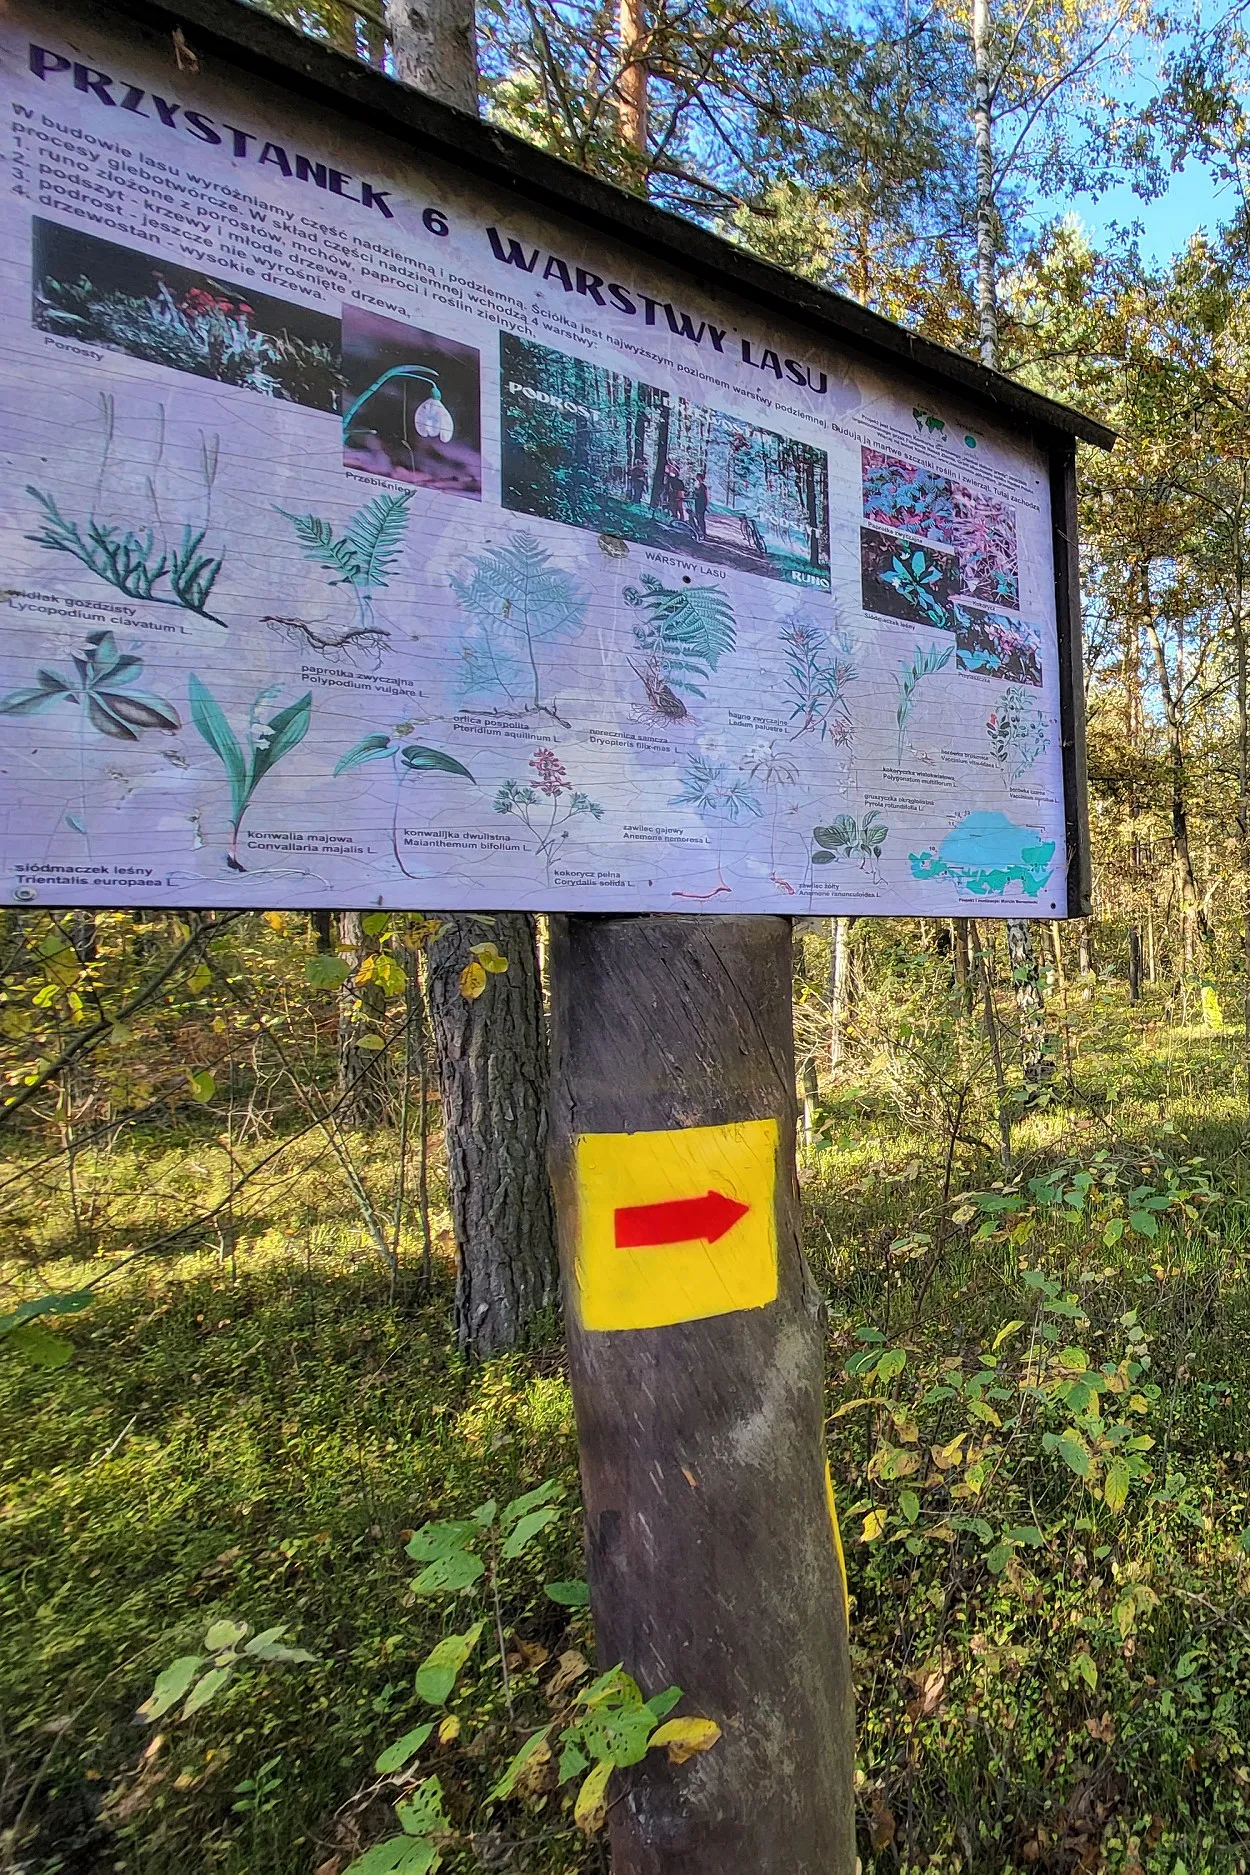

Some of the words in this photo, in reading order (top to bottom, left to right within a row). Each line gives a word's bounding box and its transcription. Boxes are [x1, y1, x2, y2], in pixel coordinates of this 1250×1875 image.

[12, 152, 31, 168] 2.
[39, 164, 126, 201] podszyt
[144, 200, 211, 234] krzewy
[228, 232, 284, 258] młode
[289, 254, 353, 284] drzewa,
[29, 42, 395, 219] PRZYSTANEK
[422, 208, 449, 237] 6
[486, 226, 727, 354] WARSTWY
[742, 338, 828, 394] LASU
[11, 184, 32, 200] 4.
[38, 193, 161, 244] drzewostan
[180, 244, 256, 276] wysokie
[261, 271, 326, 302] drzewa.
[12, 122, 100, 162] procesy
[108, 157, 244, 216] glebotwórcze.
[249, 208, 267, 222] W
[272, 220, 318, 242] skład
[324, 238, 374, 264] części
[378, 258, 464, 299] nadziemnej
[468, 292, 528, 324] wchodzą
[531, 316, 539, 326] 4
[542, 321, 598, 349] warstwy:
[12, 166, 30, 183] 3.
[39, 178, 124, 216] podrost
[142, 214, 214, 248] jeszcze
[220, 242, 247, 260] nie
[252, 254, 346, 294] wyrośnięte
[352, 289, 411, 319] drzewa,
[13, 136, 30, 151] 1.
[38, 146, 89, 172] runo
[96, 168, 175, 204] złożone
[180, 200, 192, 210] z
[196, 206, 286, 246] porostów,
[292, 240, 356, 272] mchów,
[360, 267, 418, 294] paproci
[432, 293, 473, 314] roślin
[477, 308, 536, 338] zielnych,
[12, 102, 34, 119] W
[42, 114, 132, 158] budowie
[140, 152, 180, 177] lasu
[186, 171, 295, 221] wyróżniamy
[300, 215, 348, 240] część
[353, 236, 436, 277] nadziemną
[449, 273, 528, 310] podziemną.
[531, 302, 578, 329] Ściółka
[580, 323, 604, 340] jest
[606, 334, 674, 368] najwyższym
[677, 364, 730, 390] poziomem
[733, 386, 772, 407] warstwy
[832, 422, 862, 444] Budują
[864, 435, 872, 448] ją
[873, 440, 902, 457] martwe
[904, 453, 934, 470] szczątki
[936, 464, 957, 480] roślin
[994, 487, 1010, 500] Tutaj
[44, 337, 104, 362] Porosty
[508, 381, 600, 420] PODROST
[645, 552, 698, 572] WARSTWY
[700, 566, 726, 580] LASU
[792, 570, 830, 588] RUNO
[8, 600, 106, 622] Lycopodium
[110, 616, 176, 633] clavatum
[65, 598, 137, 617] goździsty
[301, 665, 354, 680] paprotka
[357, 673, 414, 687] zwyczajna
[301, 674, 372, 691] Polypodium
[375, 686, 416, 698] vulgare
[454, 716, 482, 724] orlica
[484, 718, 530, 730] pospolita
[728, 710, 752, 722] bagno
[454, 724, 502, 736] Pteridium
[504, 730, 551, 742] aquilinum
[755, 722, 784, 734] palustre
[590, 736, 634, 748] Dryopteris
[248, 831, 304, 841] konwalia
[307, 834, 353, 844] majowa
[404, 828, 460, 840] konwalijka
[462, 832, 511, 842] dwulistna
[622, 824, 654, 832] zawilec
[655, 827, 684, 836] gajowy
[622, 832, 663, 841] Anemone
[664, 836, 704, 844] nemorosa
[248, 841, 319, 852] Convallaria
[322, 846, 364, 854] majalis
[404, 838, 478, 849] Maianthemum
[480, 842, 520, 851] bifolium
[14, 864, 110, 874] siódmaczek
[114, 866, 153, 877] leśny
[554, 870, 596, 879] kokorycz
[596, 871, 620, 880] pełna
[16, 874, 88, 886] Trientalis
[93, 878, 162, 888] europaea
[554, 878, 597, 887] Corydalis
[599, 879, 626, 887] solida
